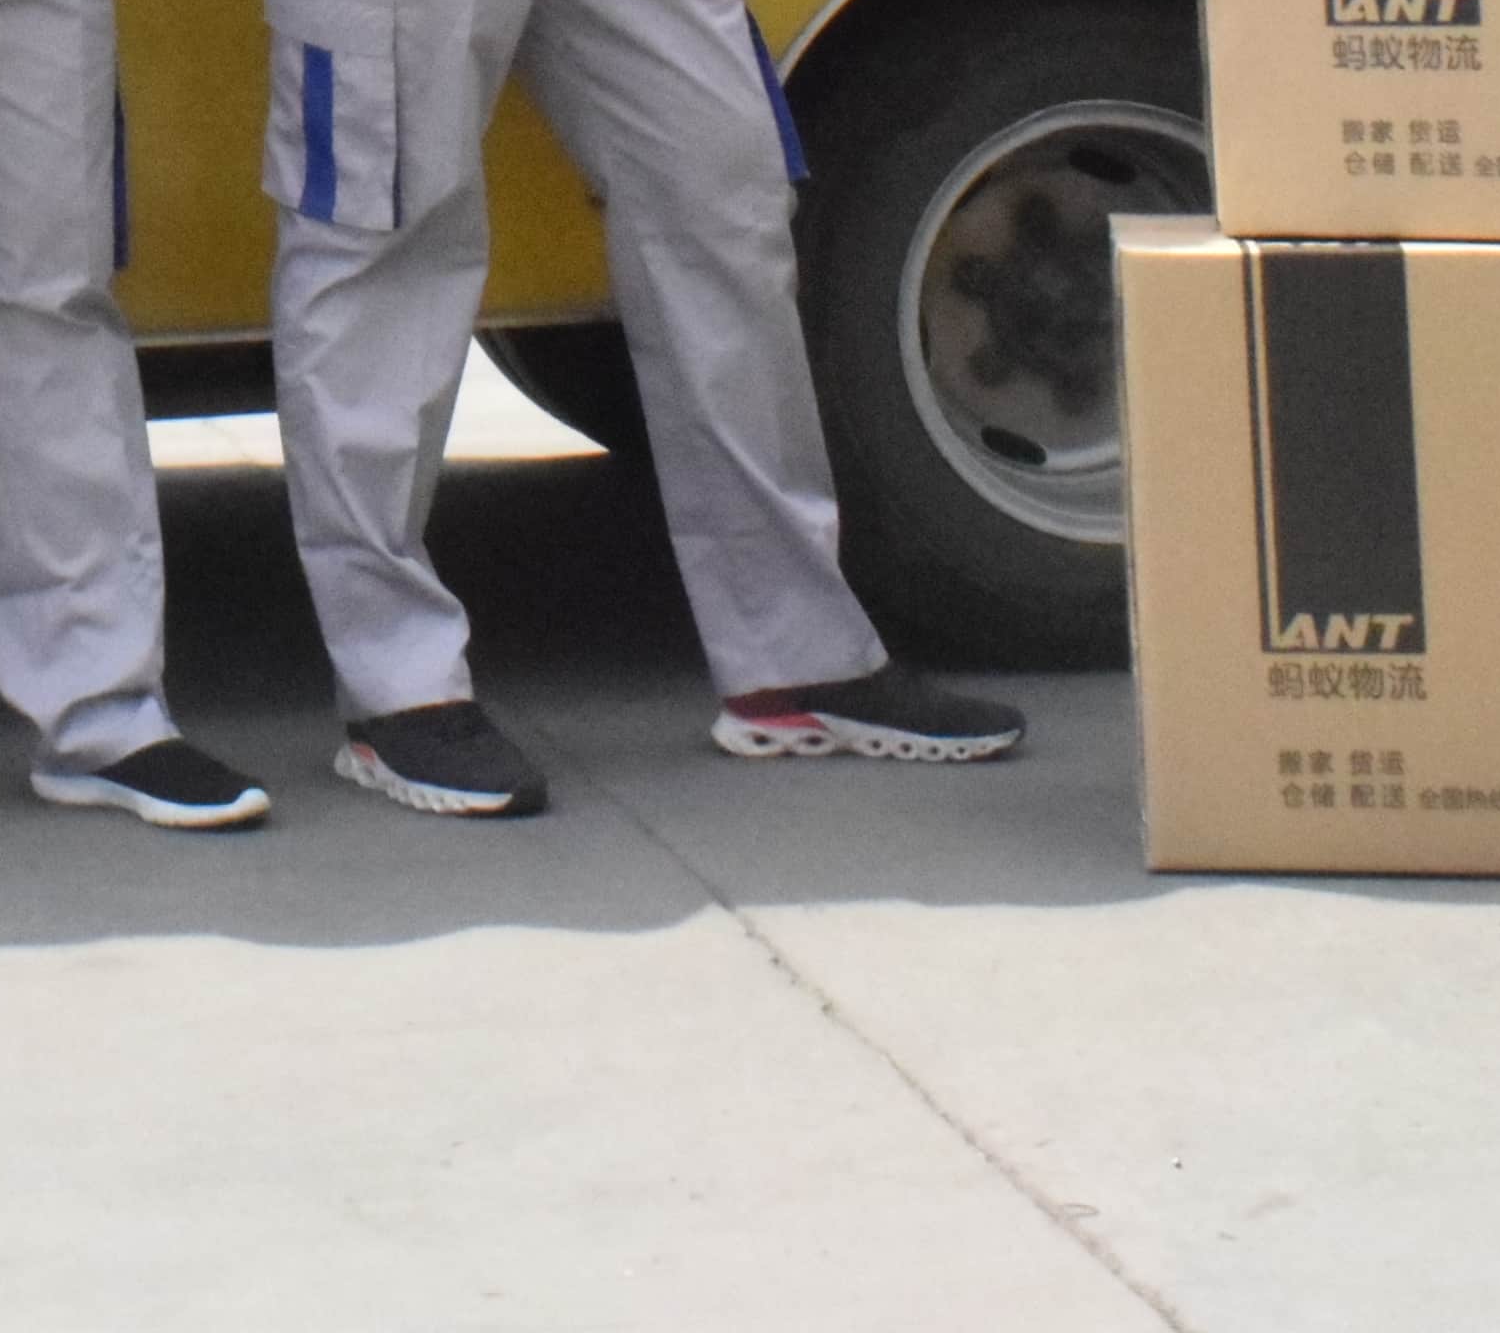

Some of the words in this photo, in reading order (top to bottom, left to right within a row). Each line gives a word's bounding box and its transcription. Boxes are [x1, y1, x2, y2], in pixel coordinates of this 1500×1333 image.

[1332, 34, 1482, 71] 蚂蚁物流
[1272, 613, 1415, 649] ANT
[1266, 662, 1428, 700] 蚂蚁物流
